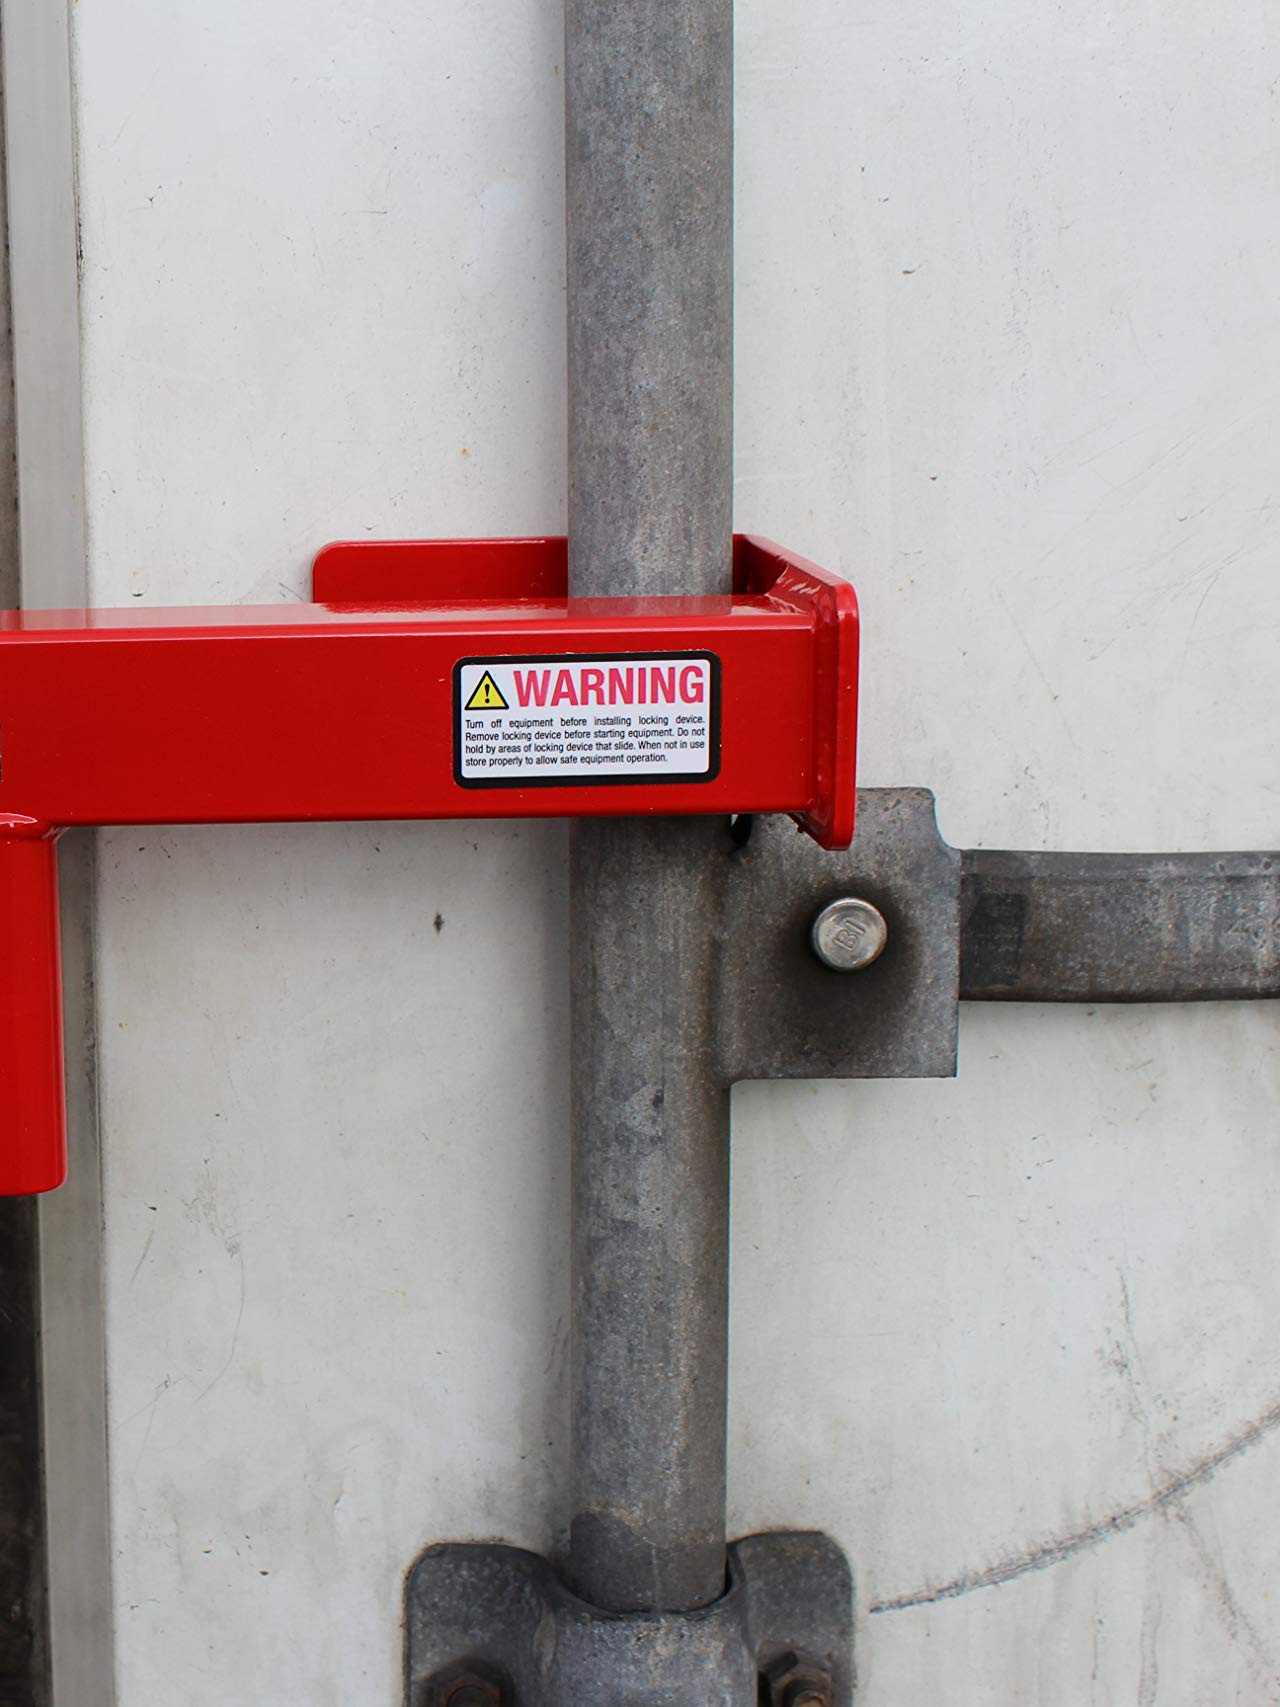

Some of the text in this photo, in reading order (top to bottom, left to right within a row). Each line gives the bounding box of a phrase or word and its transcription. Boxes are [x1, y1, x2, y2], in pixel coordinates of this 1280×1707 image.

[513, 665, 704, 707] WARNING
[465, 714, 705, 729] Turn off equipment before installing locking device.
[465, 727, 705, 741] Remove locking device before starting equipment. Do not
[465, 740, 705, 755] hold by areas of locking device that slide. When not in use
[465, 753, 668, 767] store properly to allow safe equipment operation.
